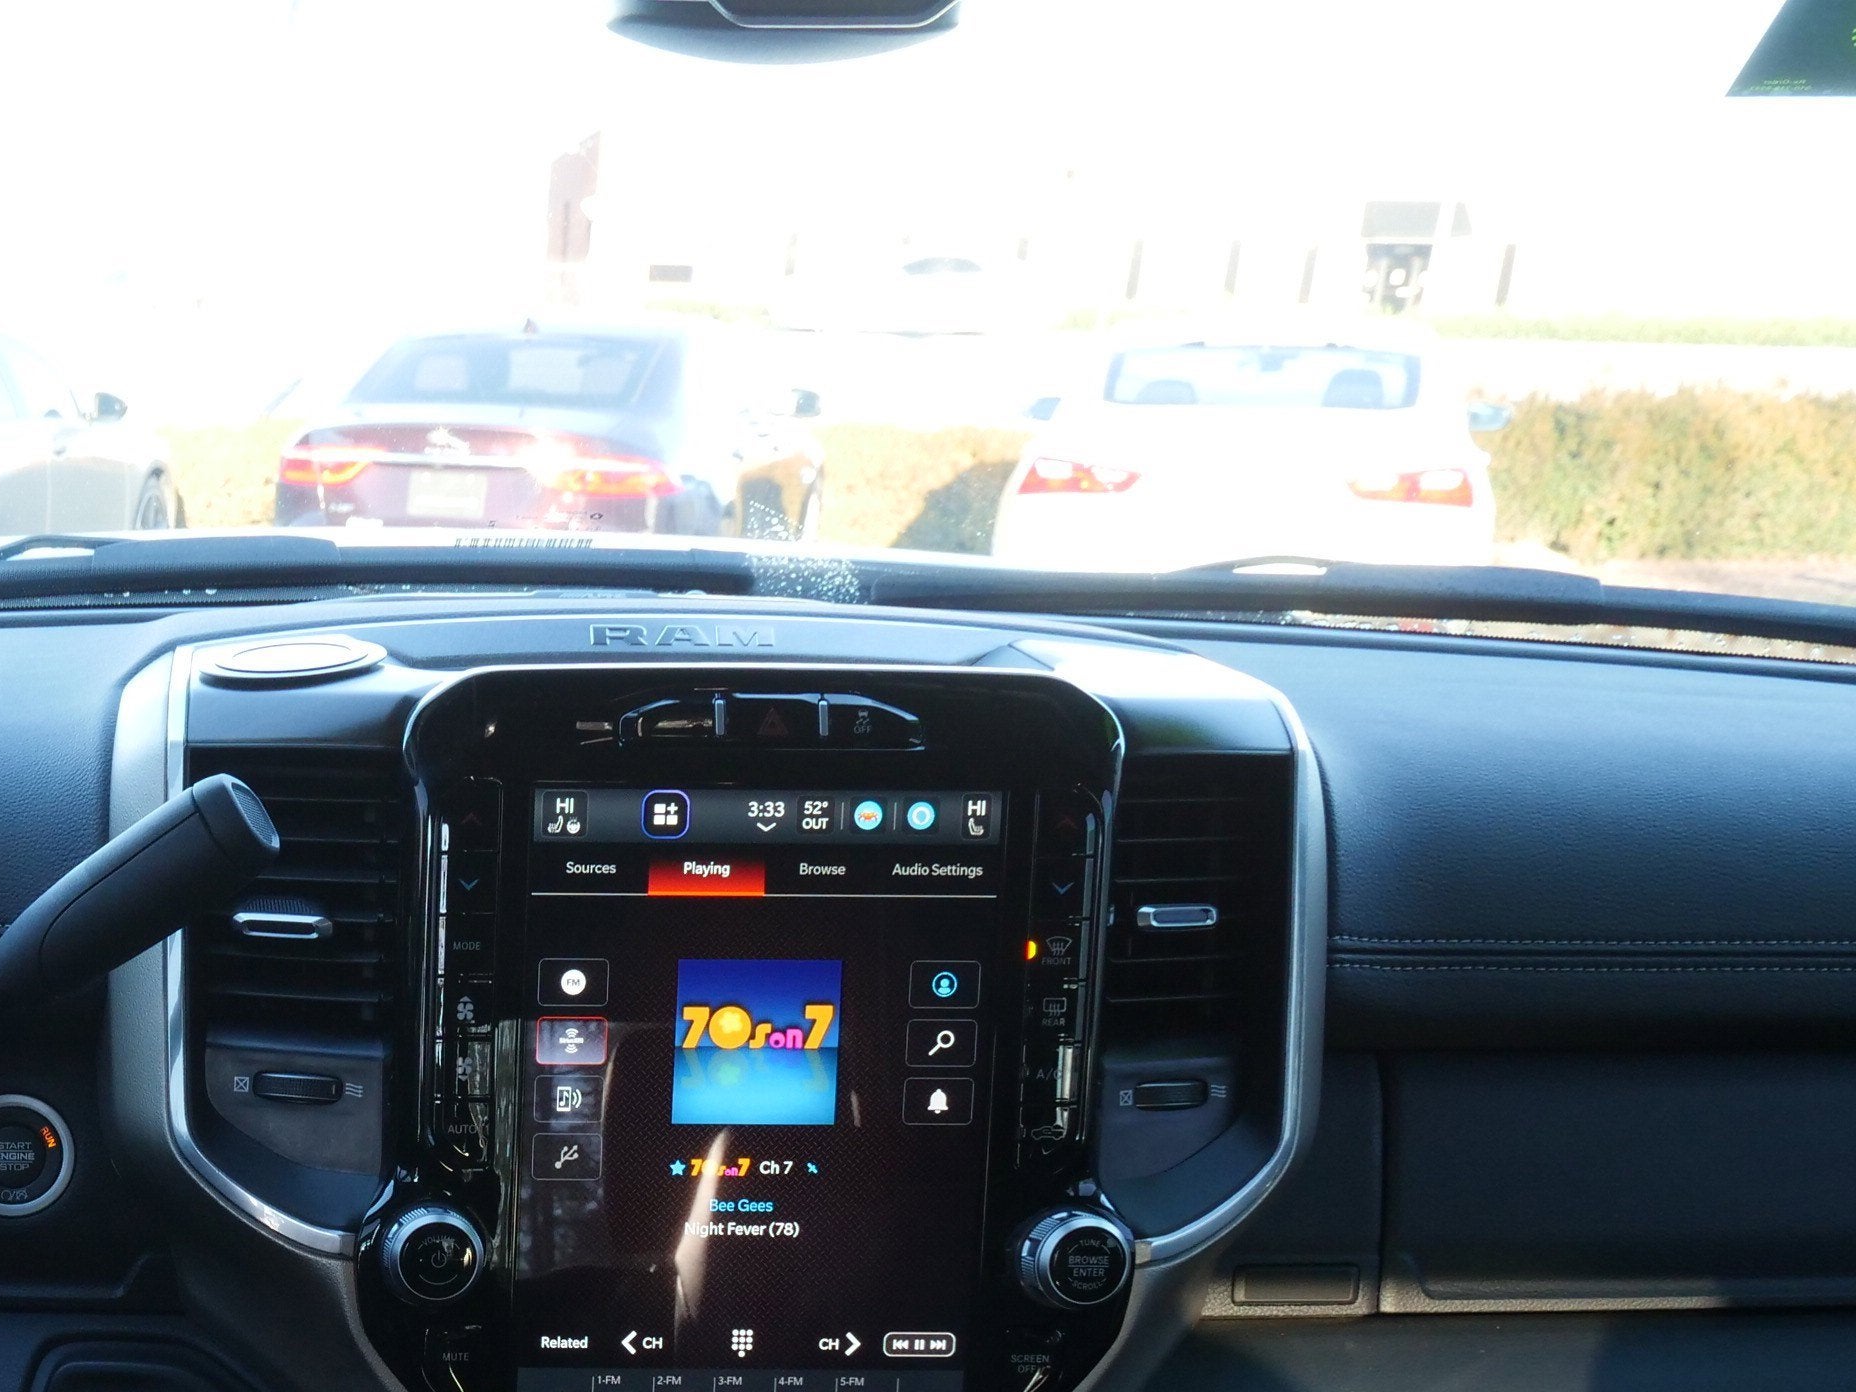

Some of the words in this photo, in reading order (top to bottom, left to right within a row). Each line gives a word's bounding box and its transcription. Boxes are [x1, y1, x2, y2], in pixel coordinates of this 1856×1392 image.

[589, 624, 775, 648] RAM
[555, 798, 574, 812] HI
[747, 801, 785, 818] 3:33
[803, 801, 829, 815] 52°
[967, 800, 985, 815] HI
[802, 817, 829, 830] OUT
[565, 861, 617, 875] Sources
[683, 861, 731, 879] Playing
[799, 862, 846, 876] Browse
[892, 863, 928, 876] Audio
[931, 863, 984, 879] Settings
[452, 941, 482, 951] MODE
[566, 979, 581, 987] FM
[40, 1126, 57, 1148] RUN
[0, 1163, 30, 1171] STOP
[759, 1161, 780, 1175] Ch
[783, 1161, 794, 1175] 7
[709, 1199, 735, 1212] Bee
[737, 1199, 774, 1212] Gees
[684, 1222, 724, 1237] Night
[727, 1222, 767, 1236] Fever
[768, 1222, 800, 1238] (78)
[1068, 1256, 1110, 1265] BROWSE
[1073, 1268, 1106, 1277] ENTER
[540, 1336, 589, 1349] Related
[642, 1337, 663, 1350] CH
[818, 1338, 839, 1351] CH
[443, 1352, 469, 1361] MUTE
[1010, 1354, 1050, 1363] SCREEN
[597, 1376, 621, 1385] 1-FM
[657, 1376, 682, 1386] 2-FM
[717, 1376, 742, 1386] 3-FM
[778, 1377, 804, 1386] 4-FM
[840, 1377, 865, 1386] 5-FM
